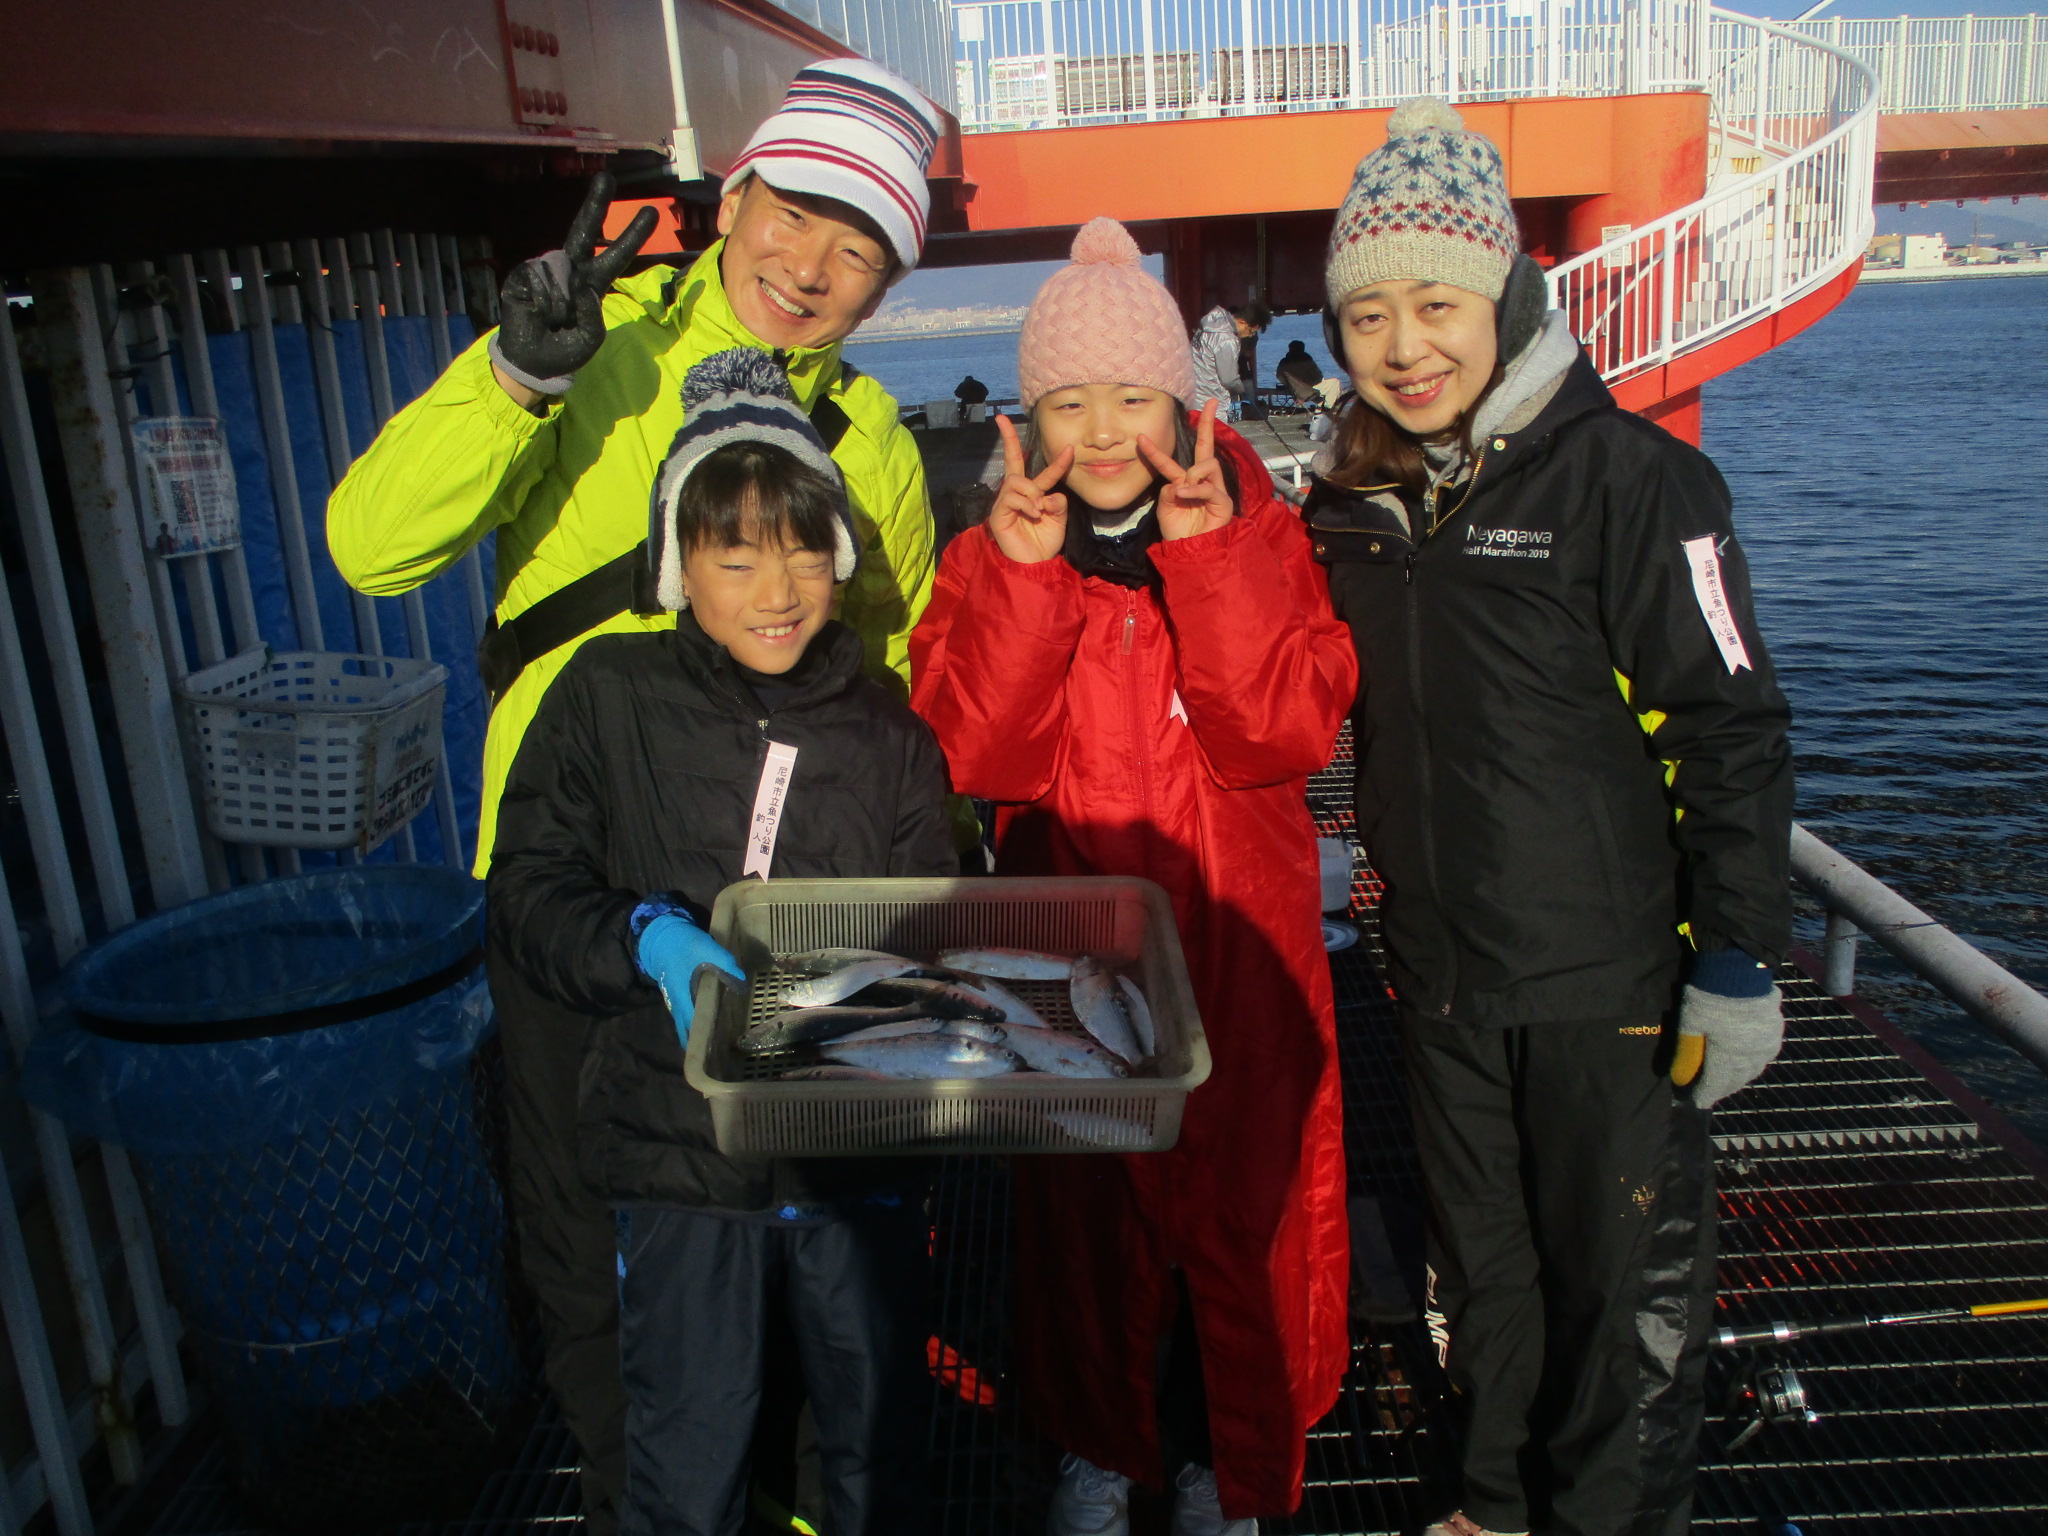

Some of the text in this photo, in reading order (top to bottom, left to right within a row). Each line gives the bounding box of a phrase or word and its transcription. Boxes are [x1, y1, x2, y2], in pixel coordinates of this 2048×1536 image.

[1463, 546, 1550, 559] Half Marathon 2019
[1466, 524, 1553, 547] Neyagawa
[759, 766, 789, 856] 尼崎市立魚つり公園
[1424, 1261, 1451, 1369] PUMP
